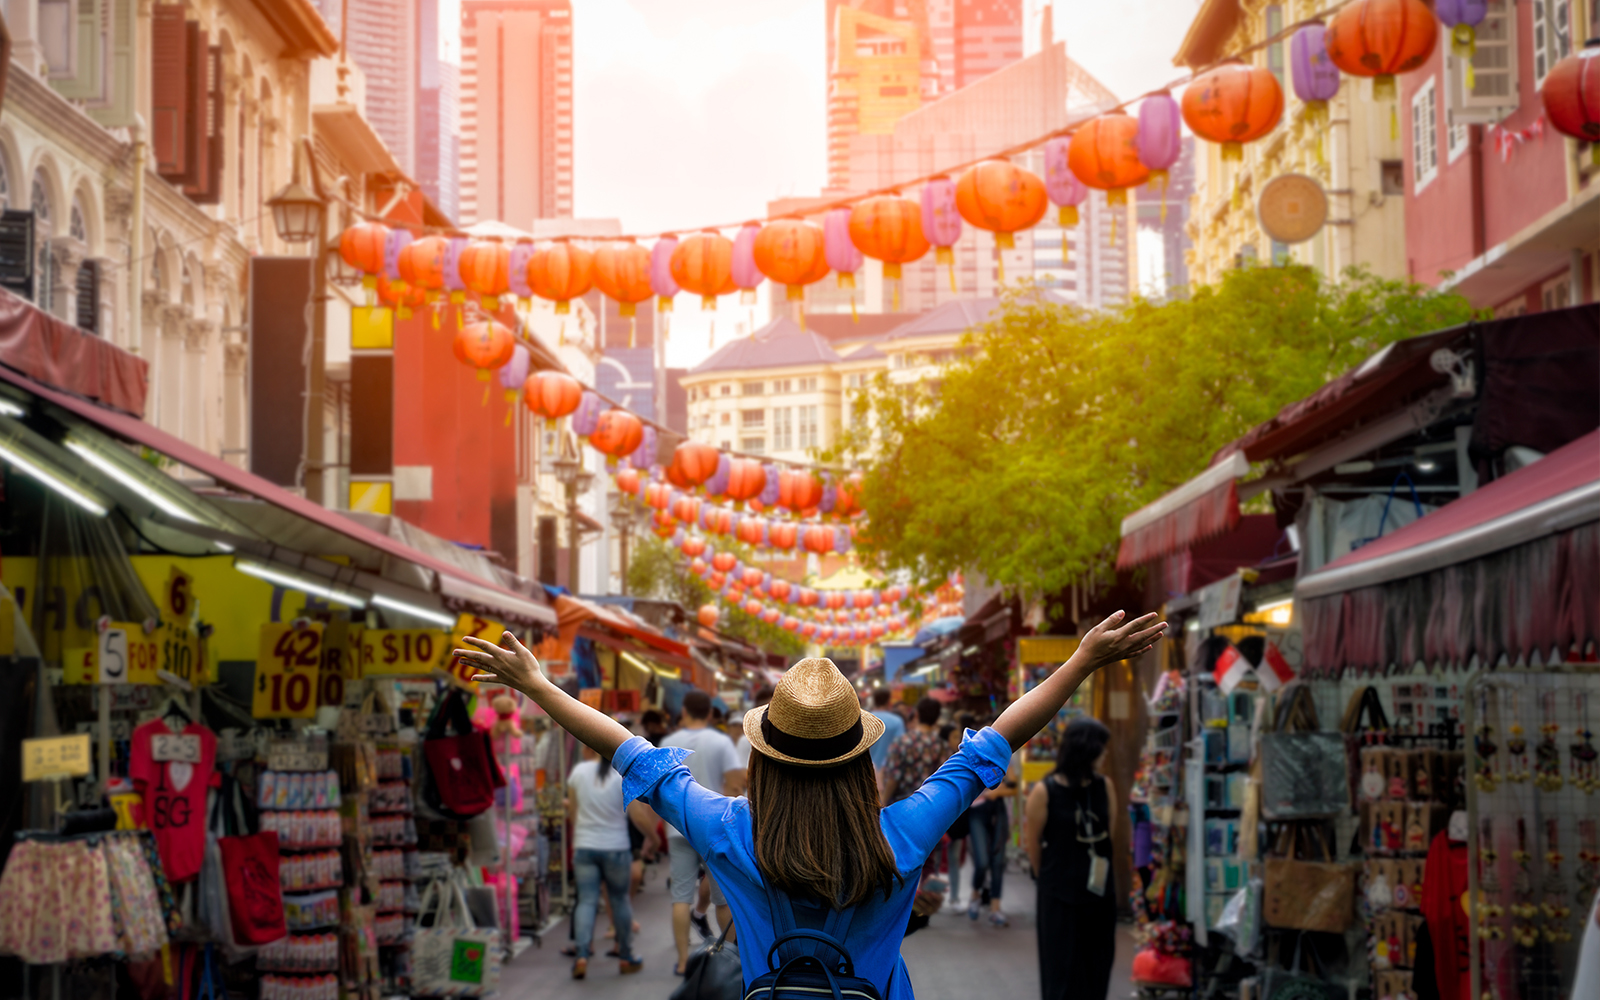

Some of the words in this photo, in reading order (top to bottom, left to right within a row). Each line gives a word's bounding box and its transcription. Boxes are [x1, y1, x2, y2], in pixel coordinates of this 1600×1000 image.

[171, 576, 187, 615] 6
[104, 632, 124, 678] 5
[129, 643, 158, 670] FOR
[163, 639, 193, 682] $10
[274, 630, 319, 667] 42
[382, 633, 432, 665] $10
[154, 795, 192, 830] SG
